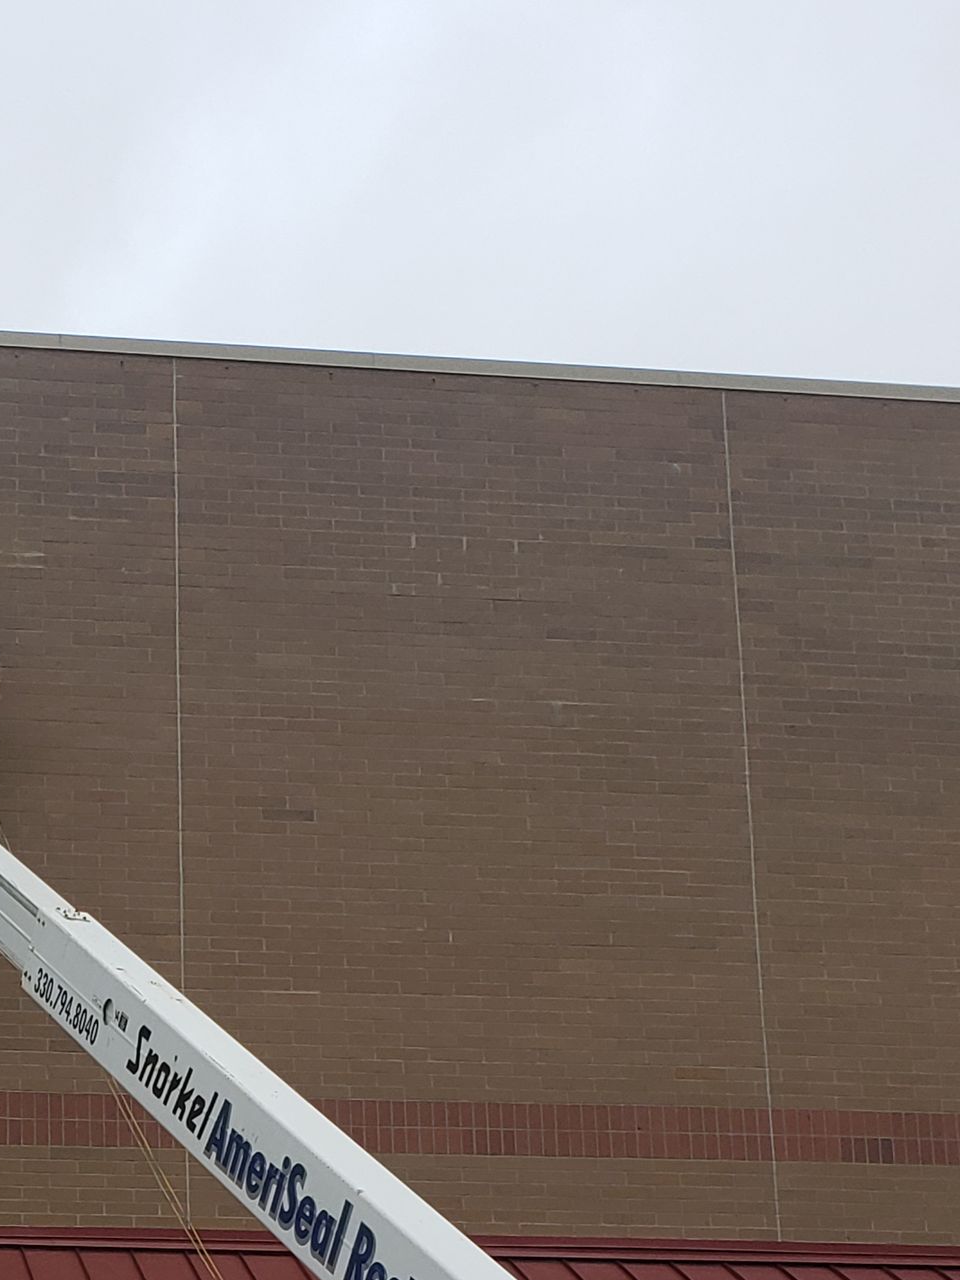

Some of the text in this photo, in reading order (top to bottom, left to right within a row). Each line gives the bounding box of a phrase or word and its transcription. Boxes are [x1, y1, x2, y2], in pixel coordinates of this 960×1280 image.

[33, 967, 100, 1046] 330.794.8040
[126, 1025, 218, 1141] Snorkel
[203, 1098, 354, 1275] AmeriSeal
